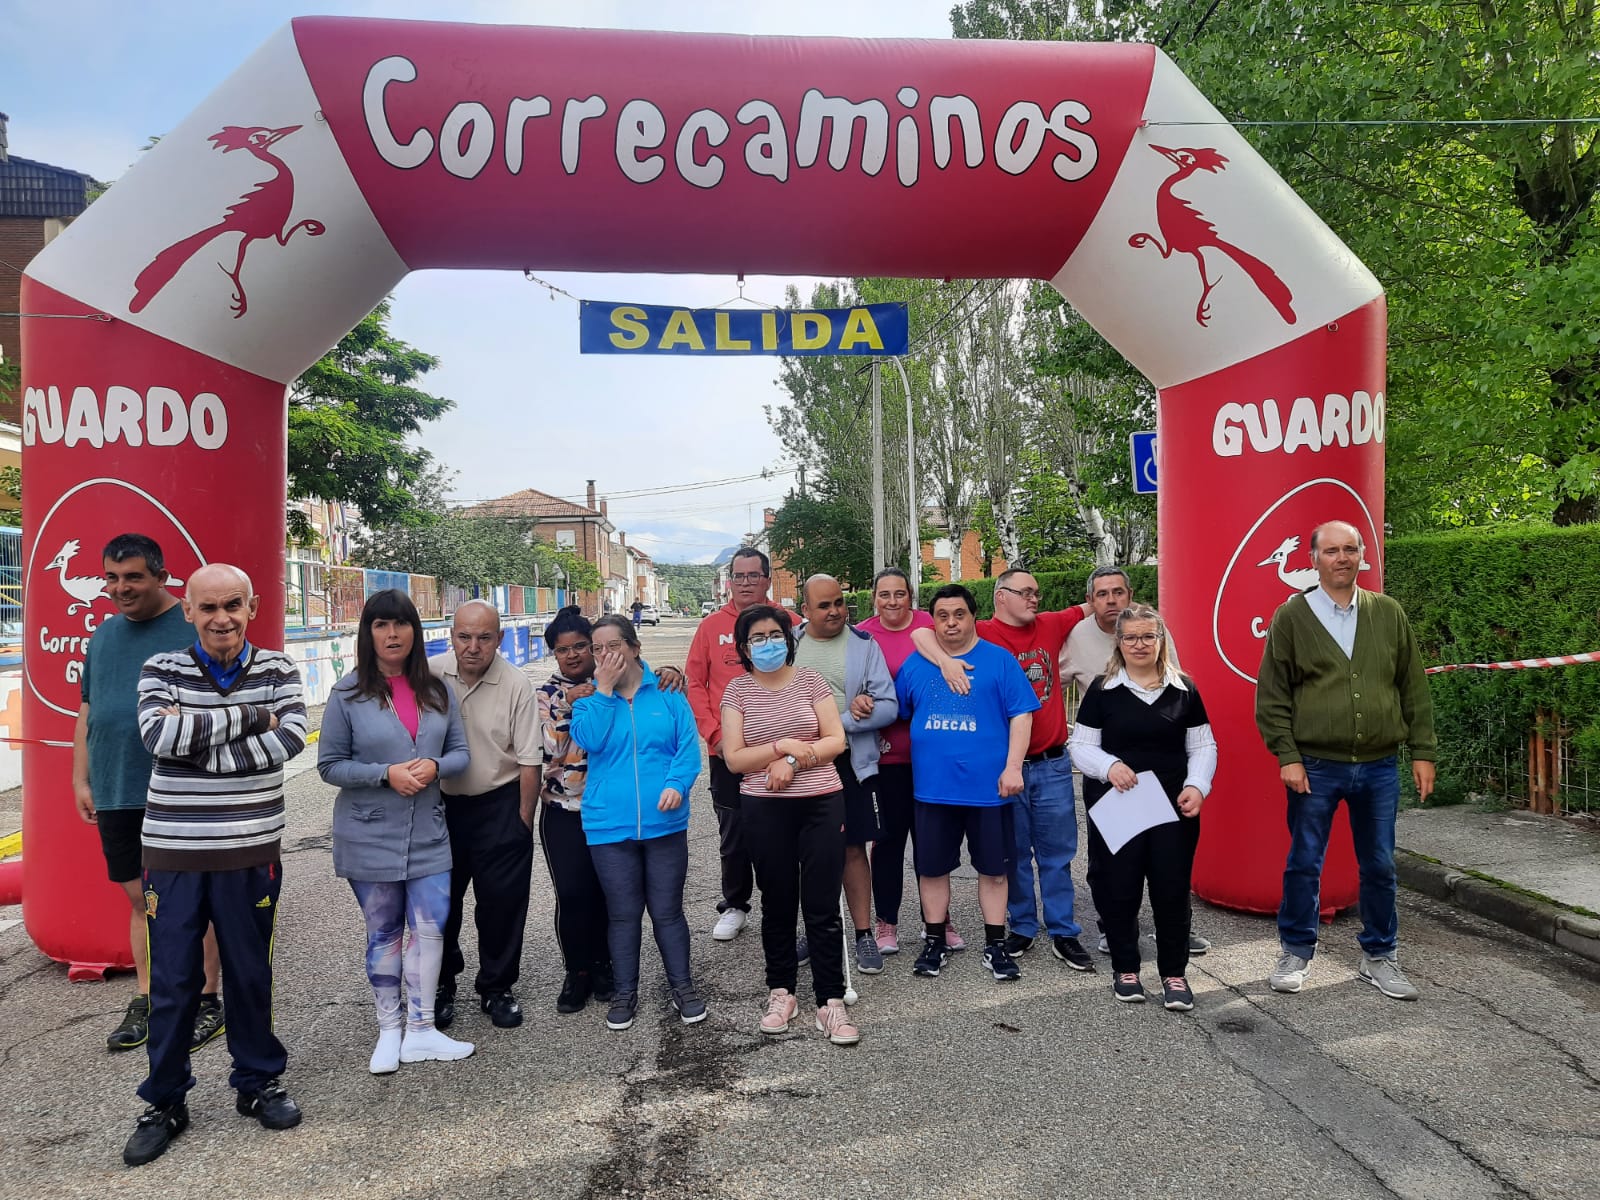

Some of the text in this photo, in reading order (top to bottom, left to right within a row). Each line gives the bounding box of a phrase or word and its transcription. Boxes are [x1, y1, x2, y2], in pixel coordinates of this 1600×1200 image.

[363, 56, 1099, 188] Correcaminos
[608, 305, 884, 352] SALIDA
[23, 386, 228, 449] GUARDO
[1212, 391, 1385, 456] GUARDO
[924, 719, 977, 731] ADECAS
